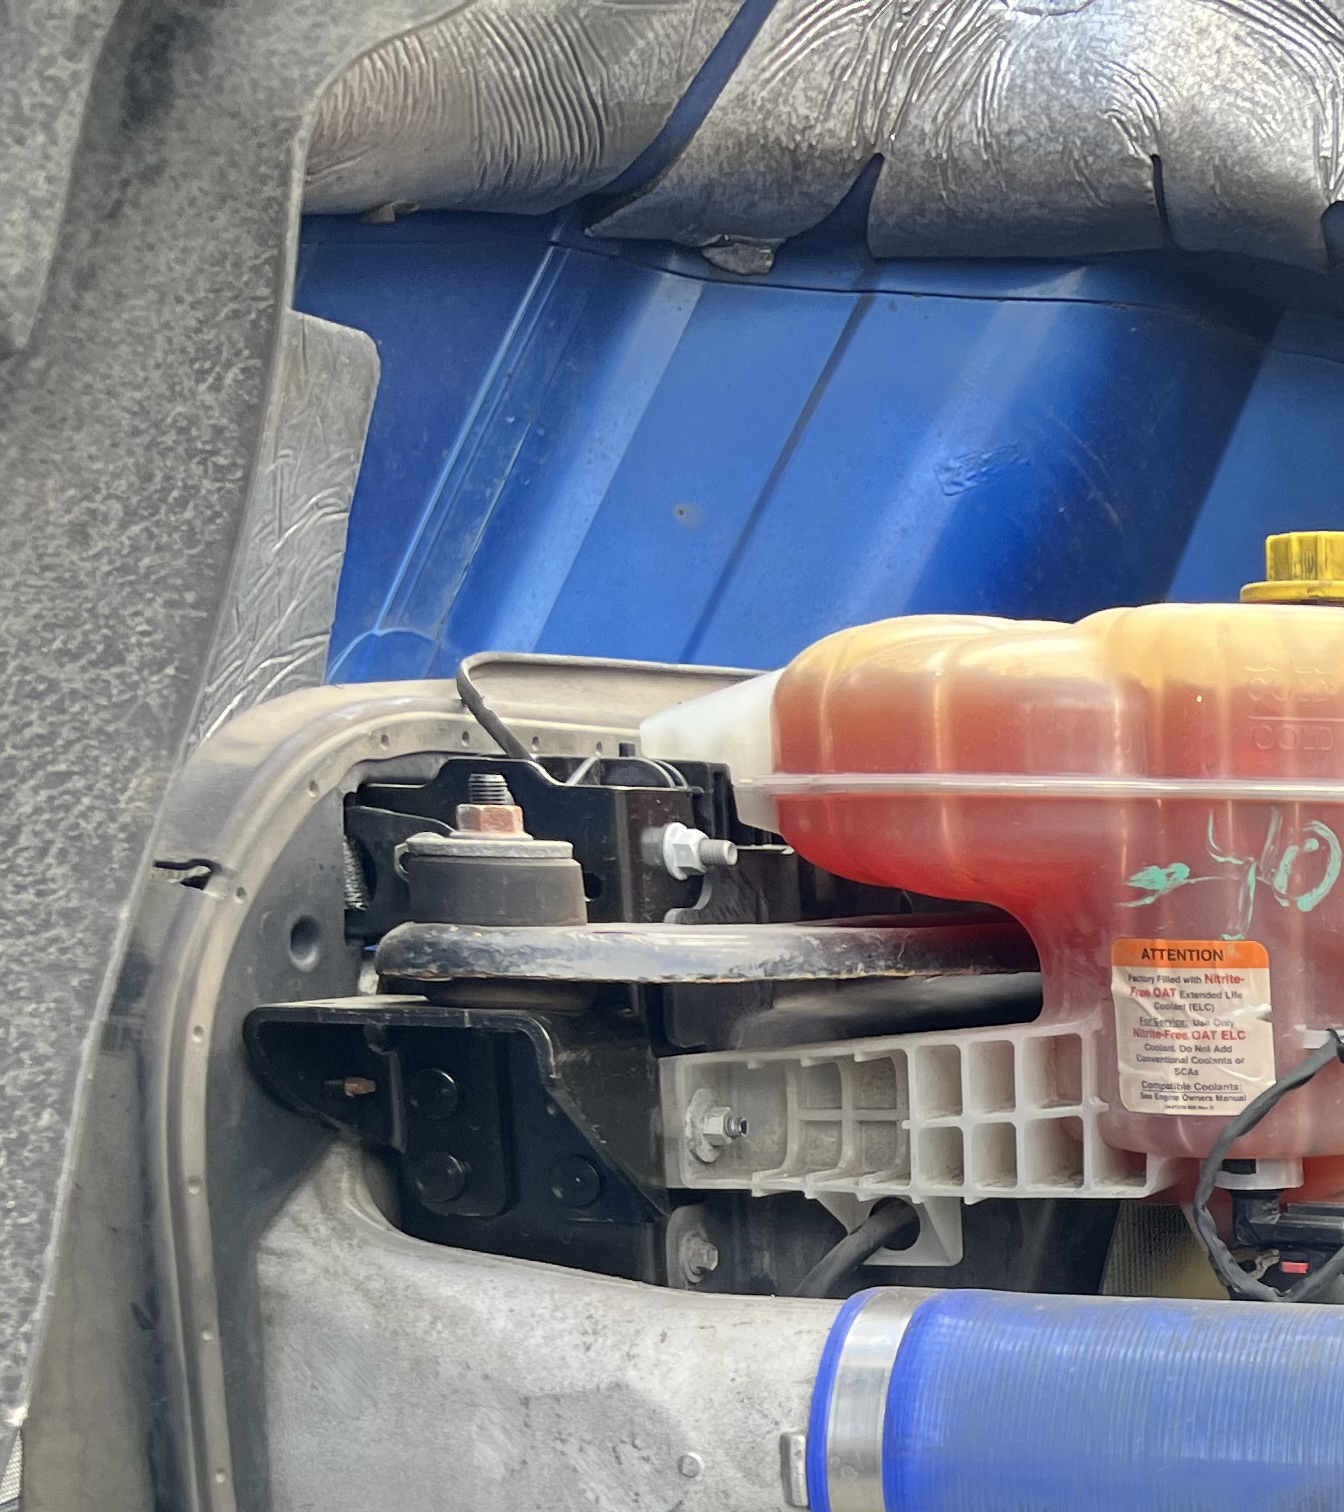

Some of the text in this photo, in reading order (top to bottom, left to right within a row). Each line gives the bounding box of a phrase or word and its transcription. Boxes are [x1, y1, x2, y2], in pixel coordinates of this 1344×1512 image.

[1252, 722, 1336, 751] COLD
[1140, 947, 1224, 963] ATTENTION
[1127, 973, 1246, 985] Factory Filled with Nitrite-
[1130, 986, 1244, 1000] Free OAT Extended Life
[1153, 1001, 1215, 1014] Coolant (ELC)
[1139, 1016, 1154, 1027] For
[1192, 1018, 1210, 1028] Use
[1213, 1018, 1235, 1030] Only
[1133, 1029, 1247, 1041] Nitrite-Free OAT ELC
[1179, 1044, 1192, 1053] Do
[1194, 1044, 1211, 1053] Not
[1213, 1044, 1233, 1053] Add
[1136, 1055, 1245, 1065] Conventional Coolants or
[1141, 1080, 1191, 1093] Compatible
[1154, 1093, 1180, 1103] Engine
[1216, 1093, 1247, 1102] Manual
